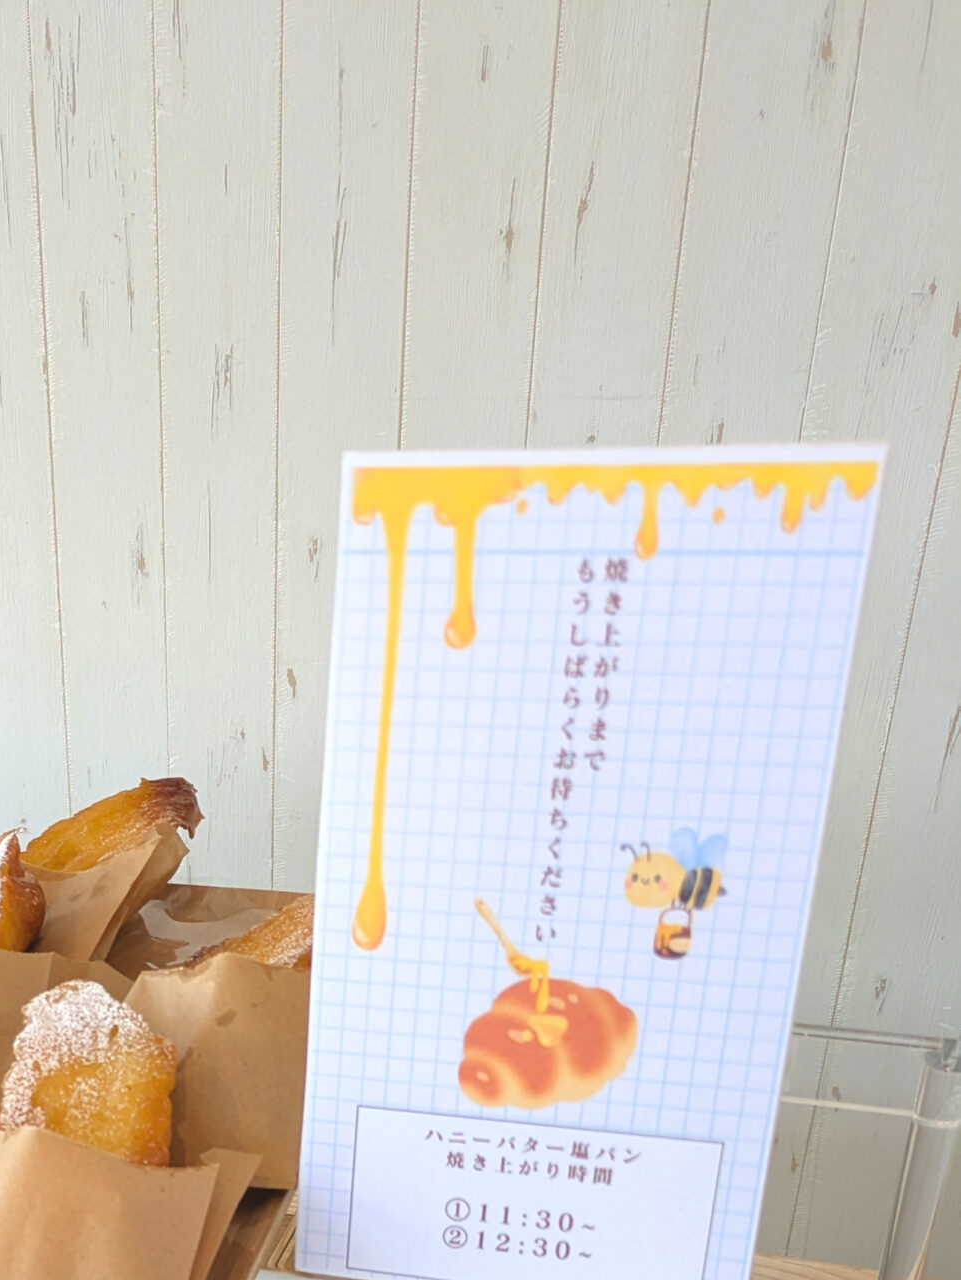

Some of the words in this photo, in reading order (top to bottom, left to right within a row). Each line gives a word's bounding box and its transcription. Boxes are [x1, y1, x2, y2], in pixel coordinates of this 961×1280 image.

[584, 557, 629, 773] 焼き上がりまで
[535, 557, 595, 943] もうしばらくお待ちください
[424, 1129, 642, 1165] ハニーバター塩パン
[446, 1151, 613, 1186] 焼き上がり時間
